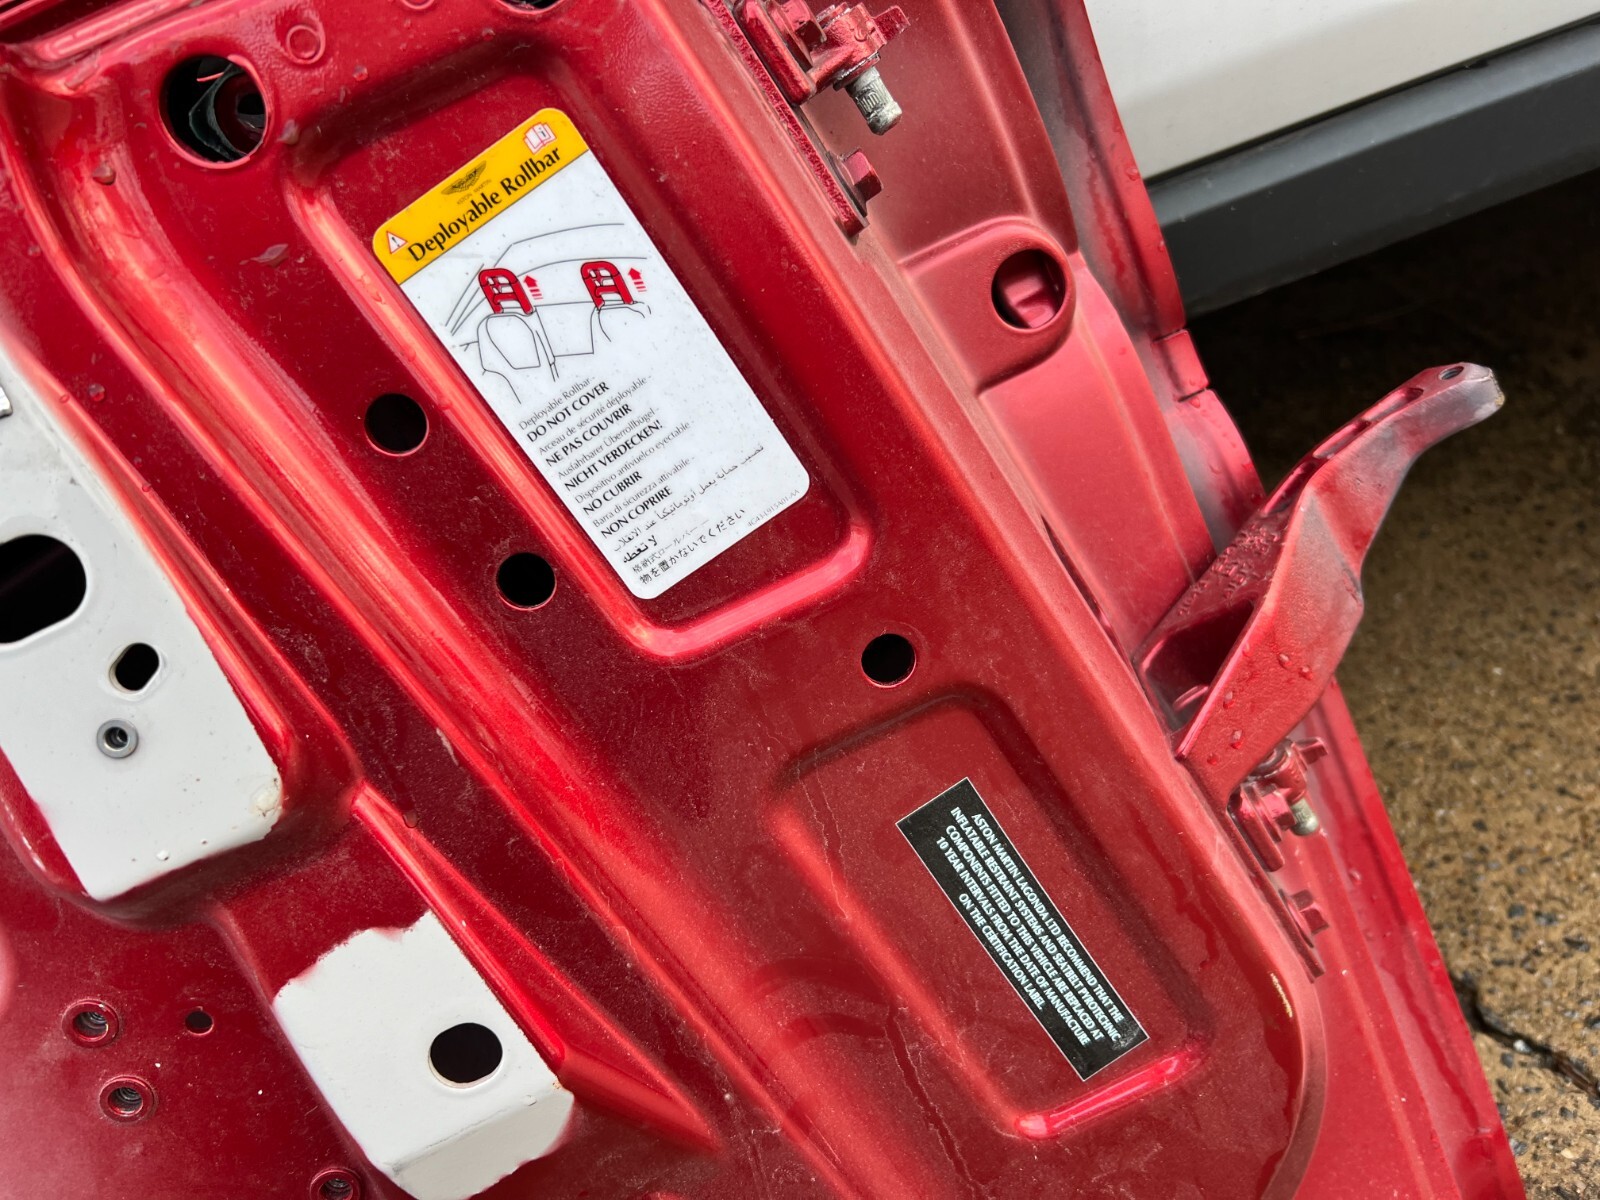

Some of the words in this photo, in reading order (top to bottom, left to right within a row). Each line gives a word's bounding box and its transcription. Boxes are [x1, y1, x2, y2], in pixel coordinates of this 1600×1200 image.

[405, 188, 504, 264] Deployable
[498, 144, 562, 196] Rollbar
[517, 396, 564, 432] Deployable
[561, 376, 591, 400] Rollbar
[525, 423, 547, 442] DO
[545, 405, 572, 429] NOT
[570, 380, 610, 412] COVER
[537, 432, 566, 455] Arceau
[564, 425, 576, 437] de
[574, 404, 606, 429] sécurité
[604, 375, 648, 410] déployable
[544, 450, 563, 467] NE
[560, 436, 583, 456] PAS
[580, 402, 633, 442] COUVRIR
[556, 443, 604, 479] Ausfahrbarer
[601, 406, 656, 448] Überrollbügel
[563, 462, 600, 491] NICHT
[597, 418, 663, 467] VERDECKEN!
[573, 471, 618, 505] Dispositivo
[615, 445, 656, 476] antivuelco
[653, 420, 691, 450] eyectable
[582, 497, 604, 514] NO
[601, 470, 643, 502] CUBRIR
[591, 510, 615, 528] Barra
[612, 503, 623, 514] di
[621, 480, 658, 507] sicurezza
[656, 457, 691, 484] attivabile
[600, 515, 629, 538] NON
[626, 485, 672, 520] COPRIRE
[638, 507, 746, 585] 物を置かないでください
[934, 835, 949, 850] 10
[942, 846, 965, 873] YEAR
[958, 869, 996, 916] INTERVALS
[989, 912, 1014, 941] FROM
[1007, 936, 1025, 957] THE
[1018, 953, 1041, 978] DATE
[1034, 974, 1050, 989] OF
[1042, 986, 1091, 1046] MANUFACTURE
[944, 823, 993, 886] COMPONENTS
[985, 882, 1012, 914] FITTED
[1005, 910, 1021, 927] TO
[1014, 923, 1035, 946] THIS
[1028, 942, 1059, 979] VEHICLE
[1051, 975, 1070, 994] ARE
[1062, 989, 1096, 1030] REPLACED
[1089, 1027, 1105, 1041] AT
[949, 805, 991, 859] INFLATABLE
[983, 855, 1021, 902] RESTRAINT
[1013, 898, 1045, 936] SYSTEMS
[1037, 933, 1058, 955] AND
[1051, 951, 1084, 990] SEATBELT
[1077, 986, 1121, 1042] PYROTECHNIC
[957, 892, 975, 910] ON
[968, 906, 987, 927] THE
[980, 923, 1029, 985] CERTIFICATION
[1022, 981, 1047, 1011] LABEL.
[970, 812, 998, 844] ASTON
[991, 841, 1021, 878] MARTIN
[1014, 875, 1050, 921] LAGONDA
[1043, 916, 1062, 936] LTD
[1055, 933, 1098, 987] RECOMMEND
[1092, 983, 1113, 1007] THAT
[1107, 1004, 1124, 1023] THE
